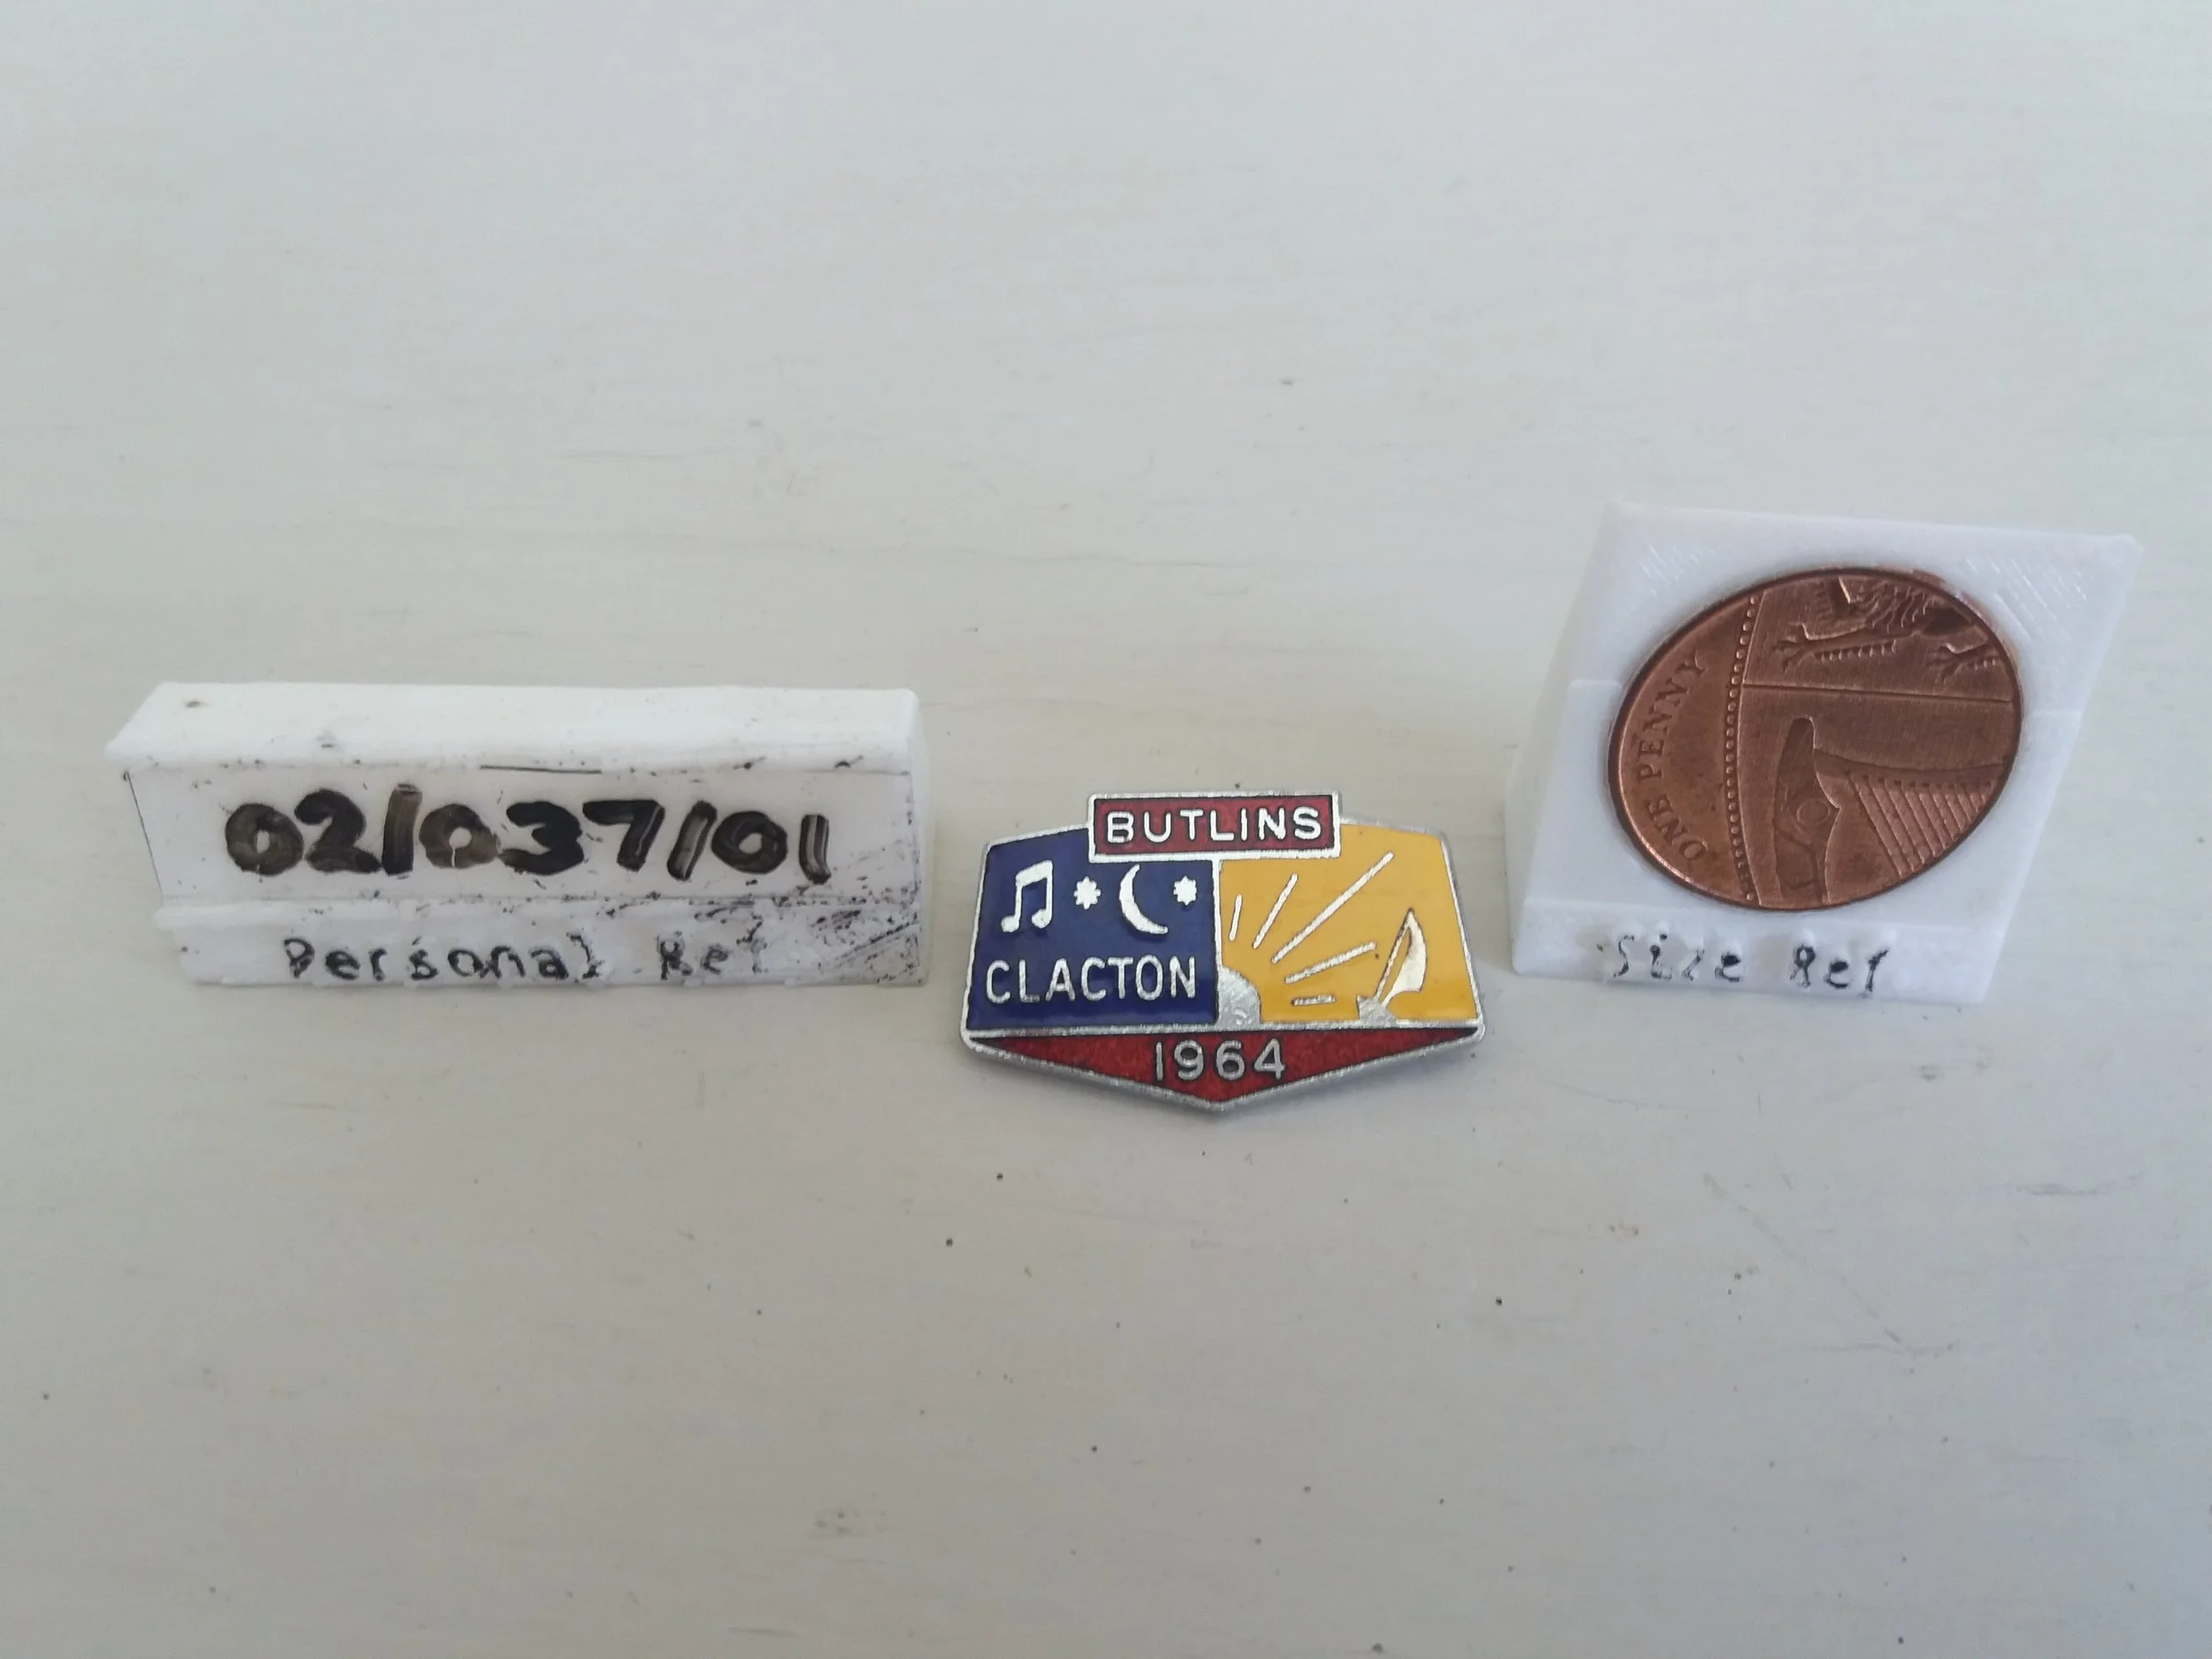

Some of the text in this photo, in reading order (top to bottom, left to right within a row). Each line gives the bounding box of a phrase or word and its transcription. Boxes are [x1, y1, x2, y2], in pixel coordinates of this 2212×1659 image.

[1637, 649, 1709, 862] ONE PENNY
[224, 782, 832, 883] 02/037/01
[1106, 806, 1323, 844] BUTLINS
[282, 933, 604, 983] Personal
[985, 956, 1195, 1004] CLACTON
[1612, 933, 1890, 994] Size Ref
[1155, 1039, 1286, 1081] 1964
